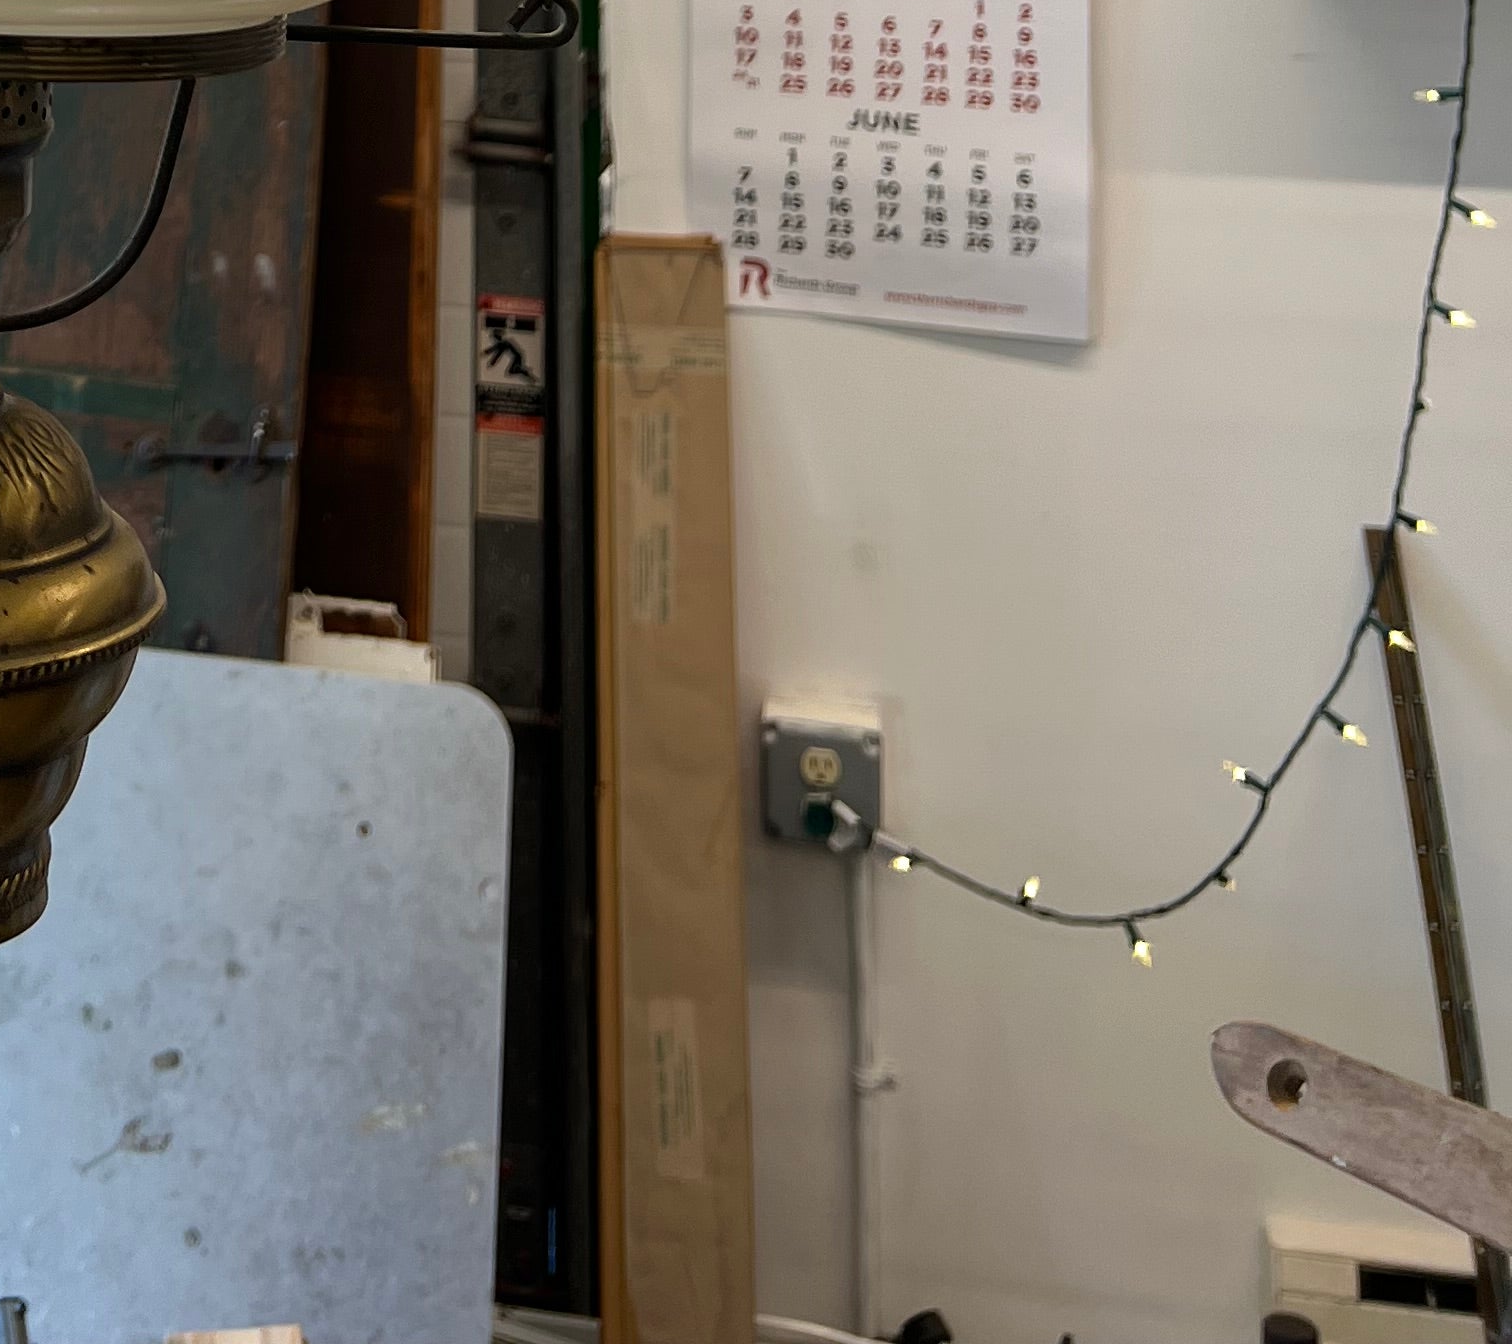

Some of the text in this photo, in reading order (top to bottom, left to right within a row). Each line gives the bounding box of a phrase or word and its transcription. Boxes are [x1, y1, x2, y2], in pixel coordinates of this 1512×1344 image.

[785, 9, 802, 26] 4
[835, 12, 848, 31] 5
[881, 16, 897, 35] 6
[929, 20, 943, 38] 7
[1017, 27, 1033, 46] 9
[975, 0, 1033, 23] 1 2
[735, 27, 1038, 69] 10 11 12 13 14 15 16
[736, 48, 757, 66] 17
[830, 56, 853, 75] 19
[874, 59, 904, 80] 20
[923, 64, 948, 83] 21
[780, 73, 807, 94] 25
[827, 78, 855, 98] 26
[875, 82, 903, 102] 27
[922, 86, 950, 106] 28
[846, 108, 921, 136] JUNE
